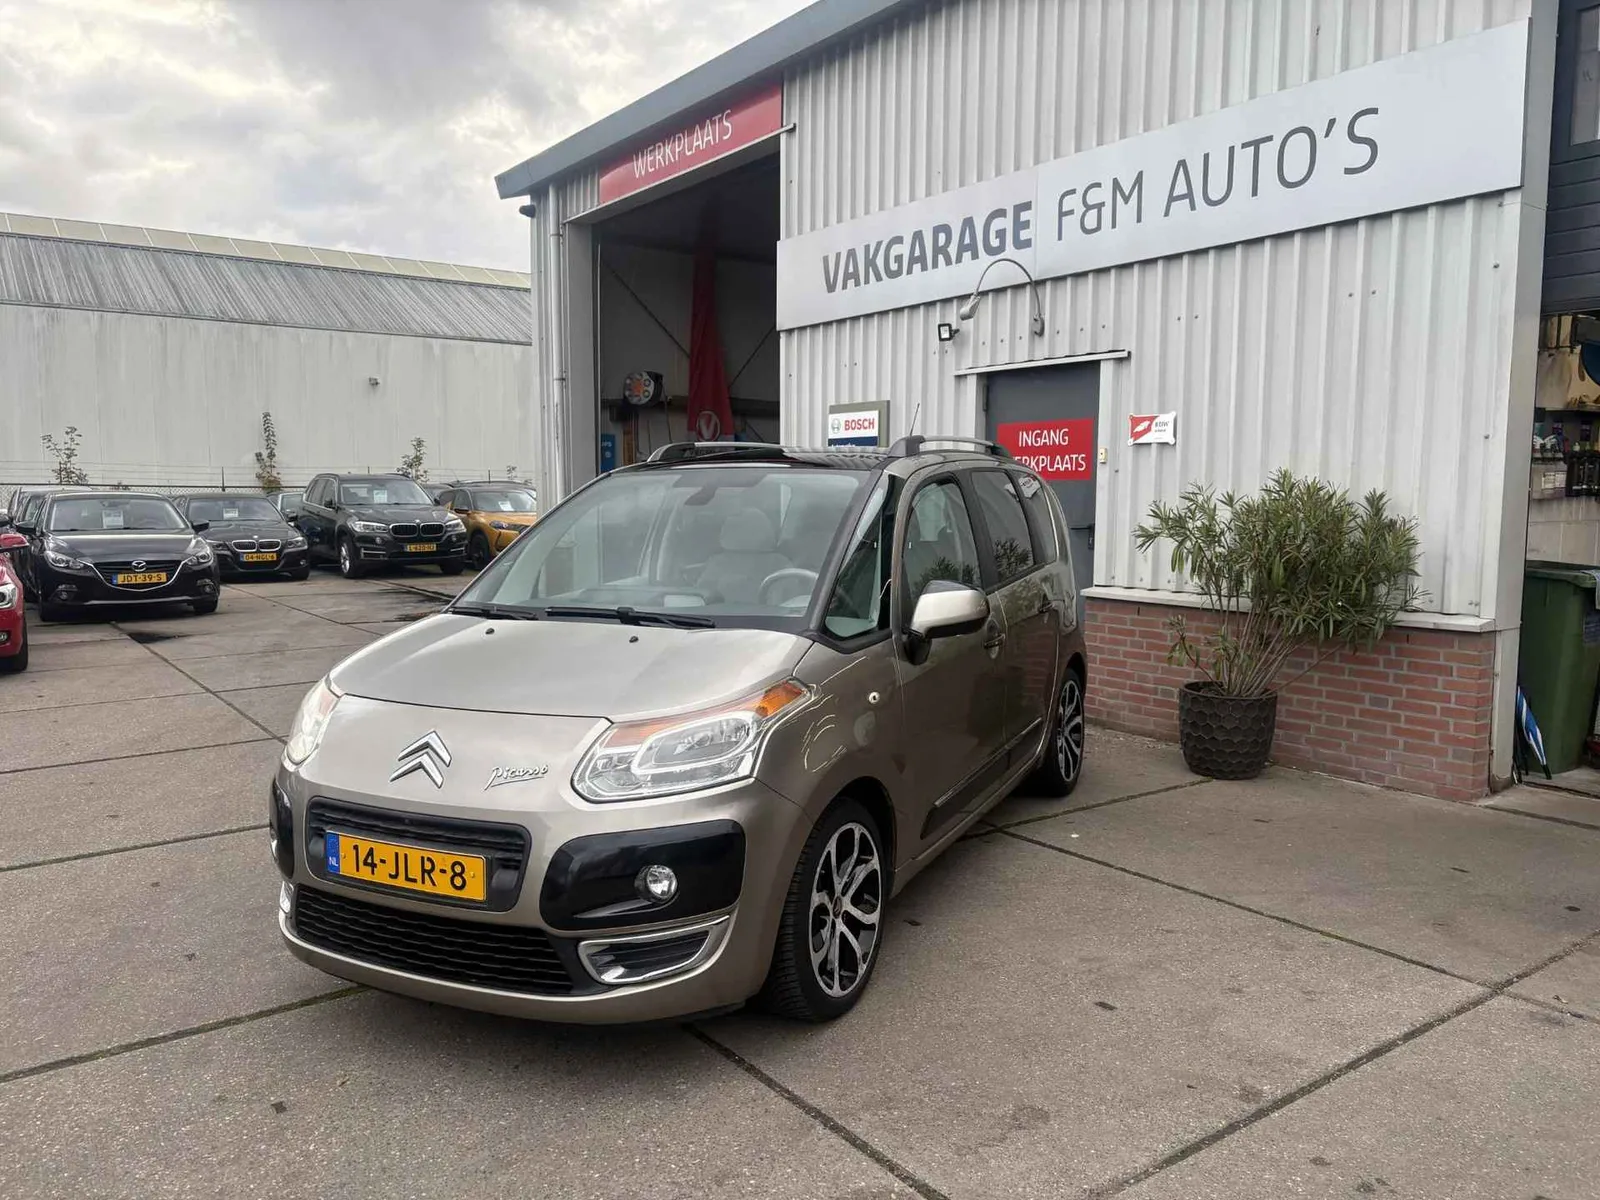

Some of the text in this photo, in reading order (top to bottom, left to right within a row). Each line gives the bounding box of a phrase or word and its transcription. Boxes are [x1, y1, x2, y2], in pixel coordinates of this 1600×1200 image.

[633, 109, 733, 179] WERKPLAATS
[822, 107, 1379, 294] VAKGARAGE F&M AUTO'S
[844, 417, 875, 431] BOSCH
[1018, 428, 1069, 448] INGANG
[1012, 454, 1087, 472] RKPLAATS
[328, 856, 339, 867] NL
[352, 844, 467, 891] 14-JLR-8
